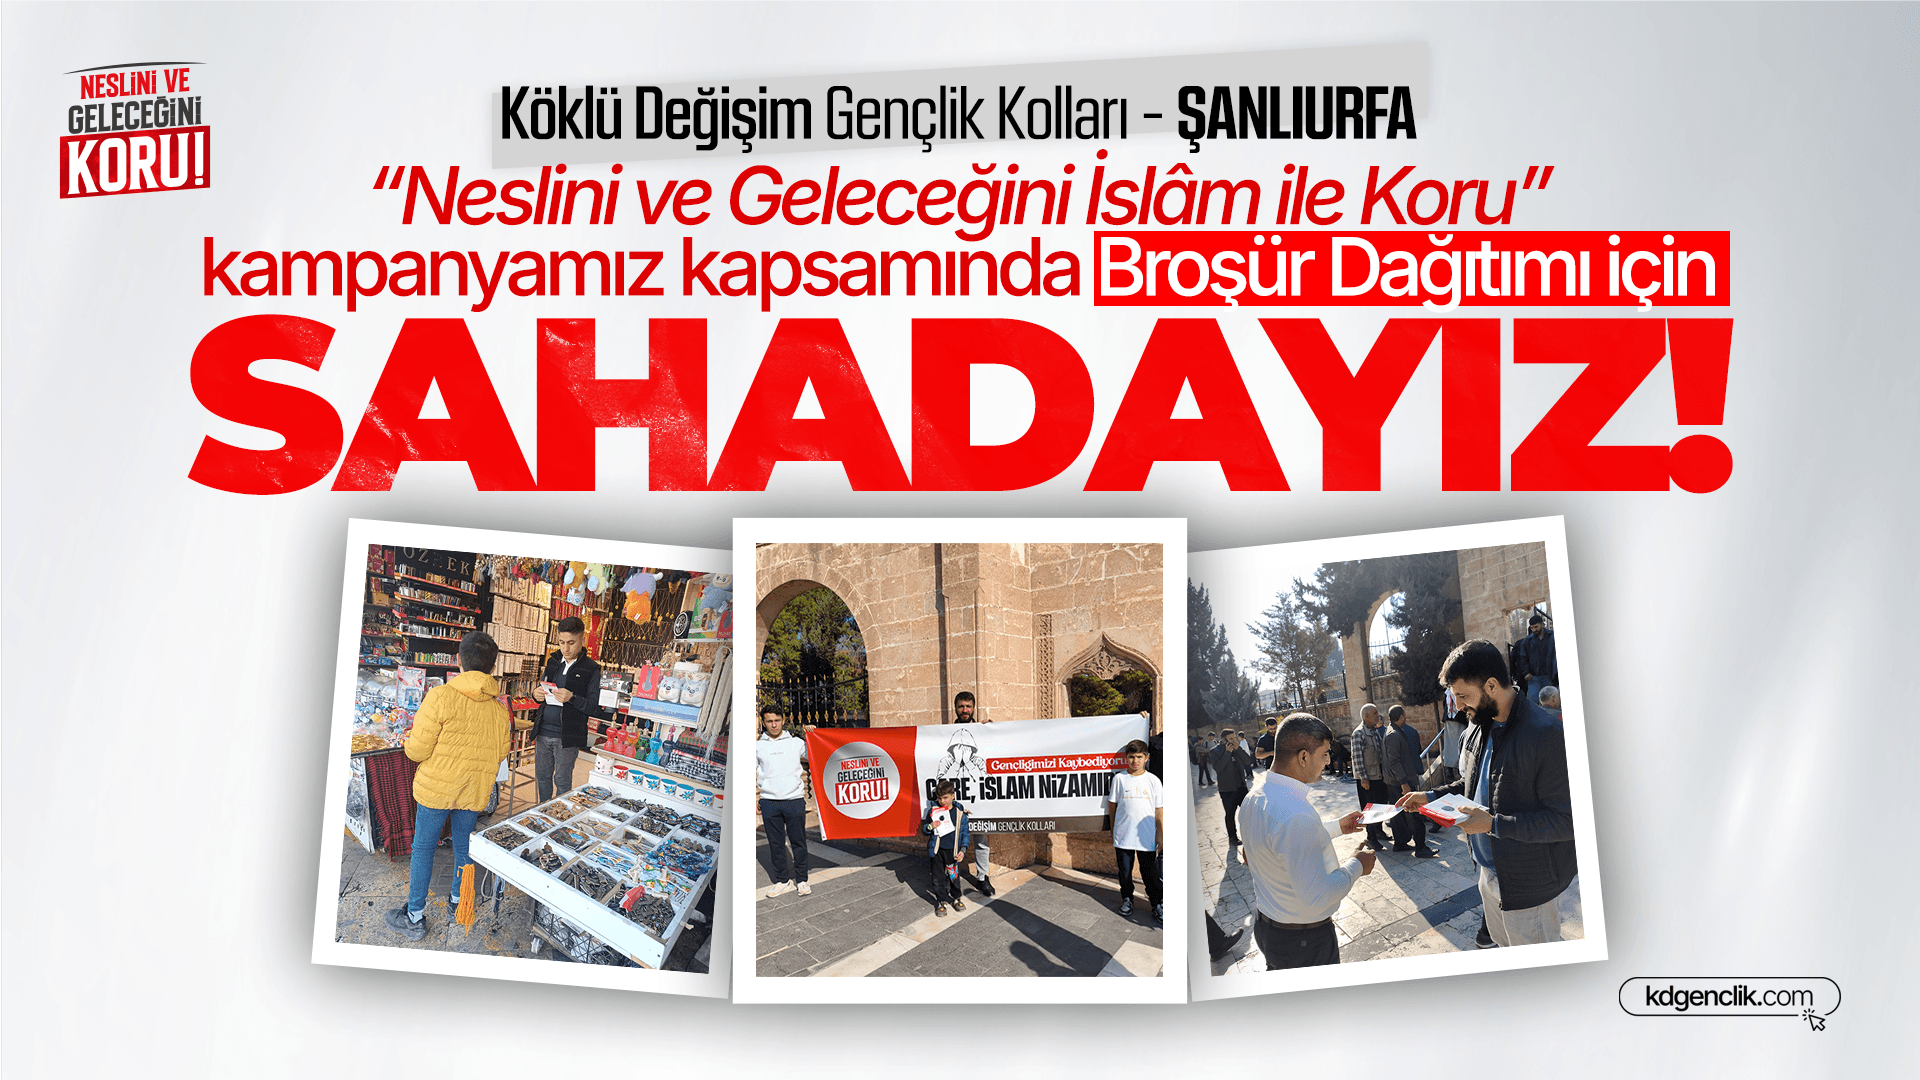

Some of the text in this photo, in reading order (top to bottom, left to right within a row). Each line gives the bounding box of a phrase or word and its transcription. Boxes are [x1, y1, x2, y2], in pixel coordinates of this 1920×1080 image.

[870, 757, 880, 767] VE
[1058, 756, 1128, 770] Kaybediyoru
[838, 779, 887, 804] KORU!
[1026, 821, 1056, 831] KOLLARI
